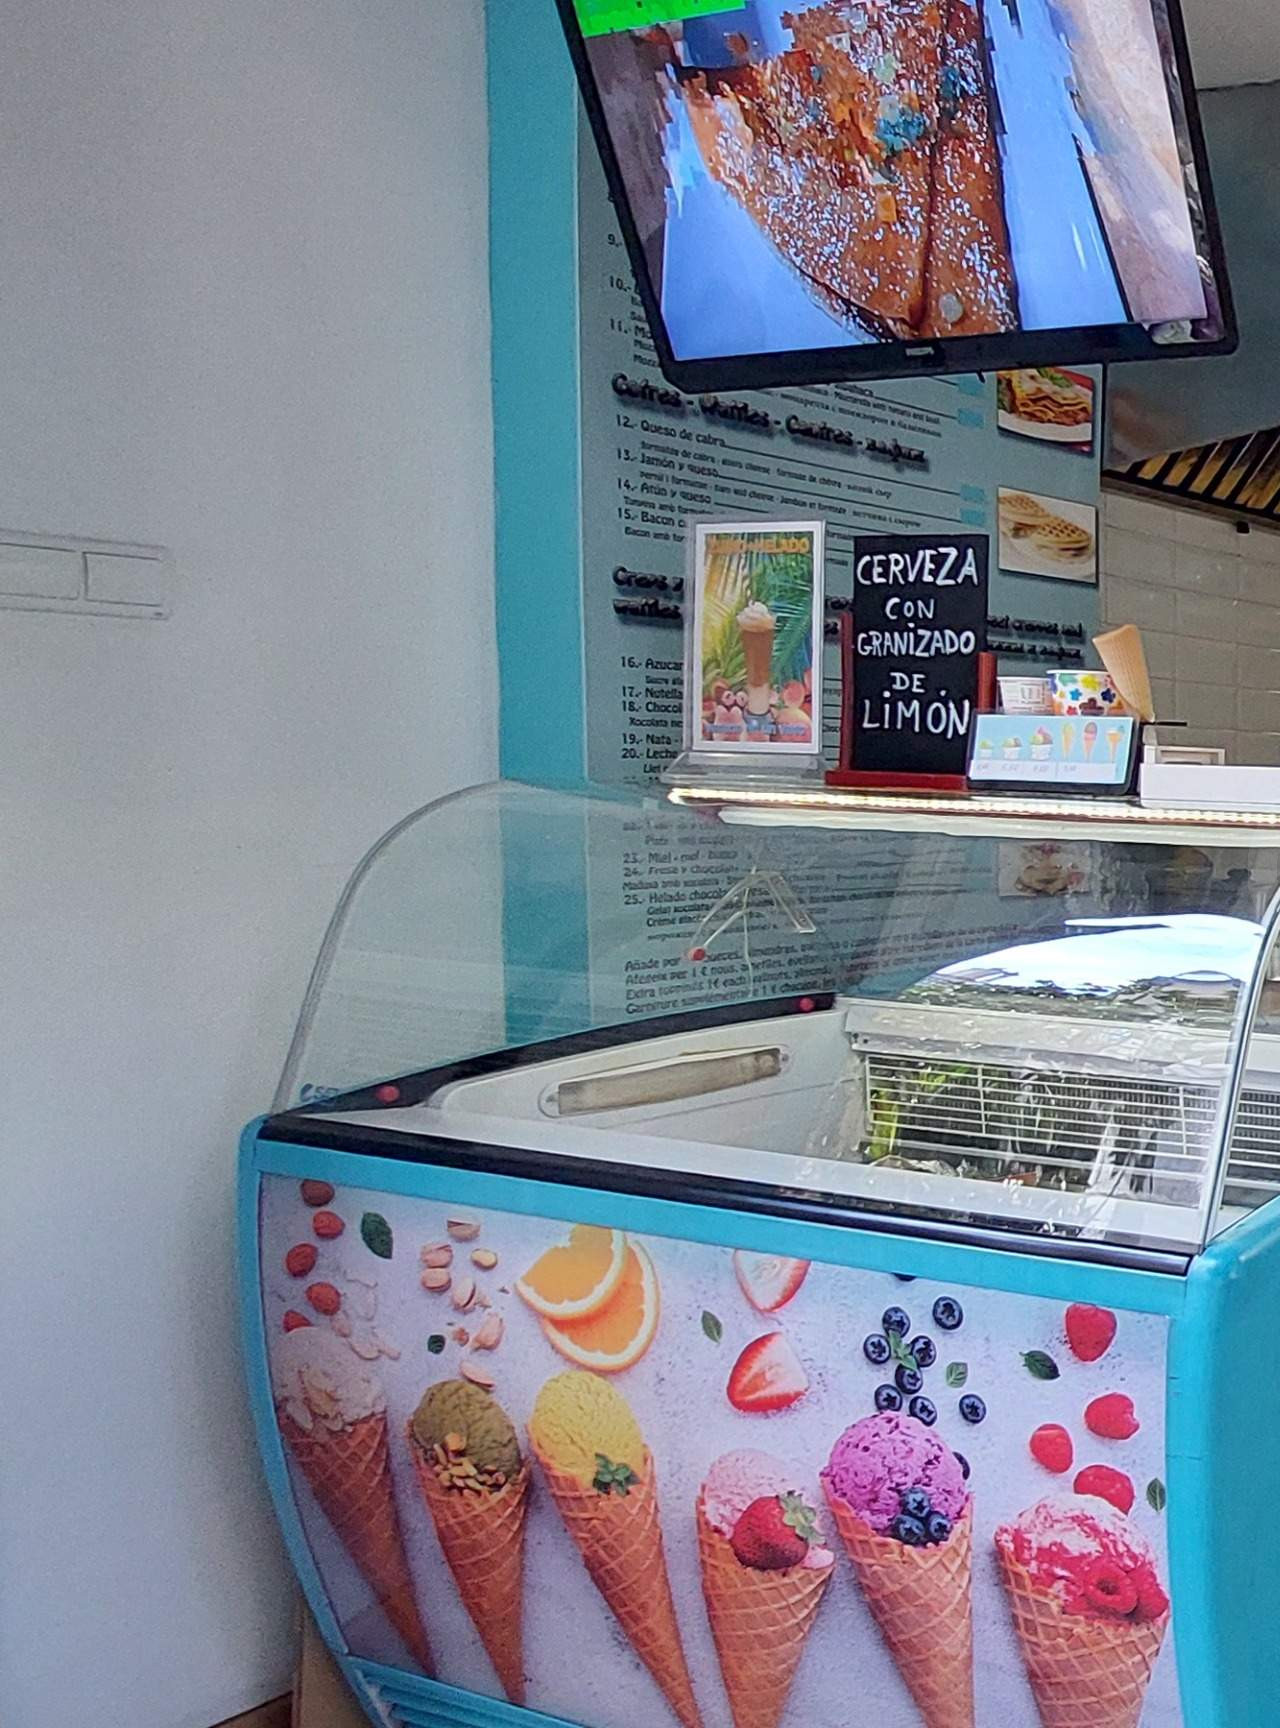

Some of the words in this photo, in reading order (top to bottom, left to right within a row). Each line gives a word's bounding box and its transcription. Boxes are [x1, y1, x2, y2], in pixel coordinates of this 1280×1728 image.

[640, 420, 677, 438] Queso
[679, 429, 693, 442] de
[695, 432, 727, 448] cabra
[616, 447, 638, 462] 13.-
[640, 453, 676, 470] Jamón
[678, 462, 685, 472] y
[617, 478, 638, 492] 14.-
[640, 482, 668, 497] Atún
[670, 489, 677, 499] y
[617, 508, 638, 521] 15.-
[640, 512, 676, 528] Bacon
[856, 547, 978, 586] CERVEZA
[885, 597, 935, 619] CON
[620, 656, 642, 670] 16.-
[621, 686, 642, 699] 17.-
[890, 672, 926, 693] DE
[621, 701, 642, 713] 18.-
[621, 733, 643, 746] 19.-
[645, 734, 672, 746] Nata
[621, 748, 643, 760] 20.-
[645, 748, 679, 760] Leche
